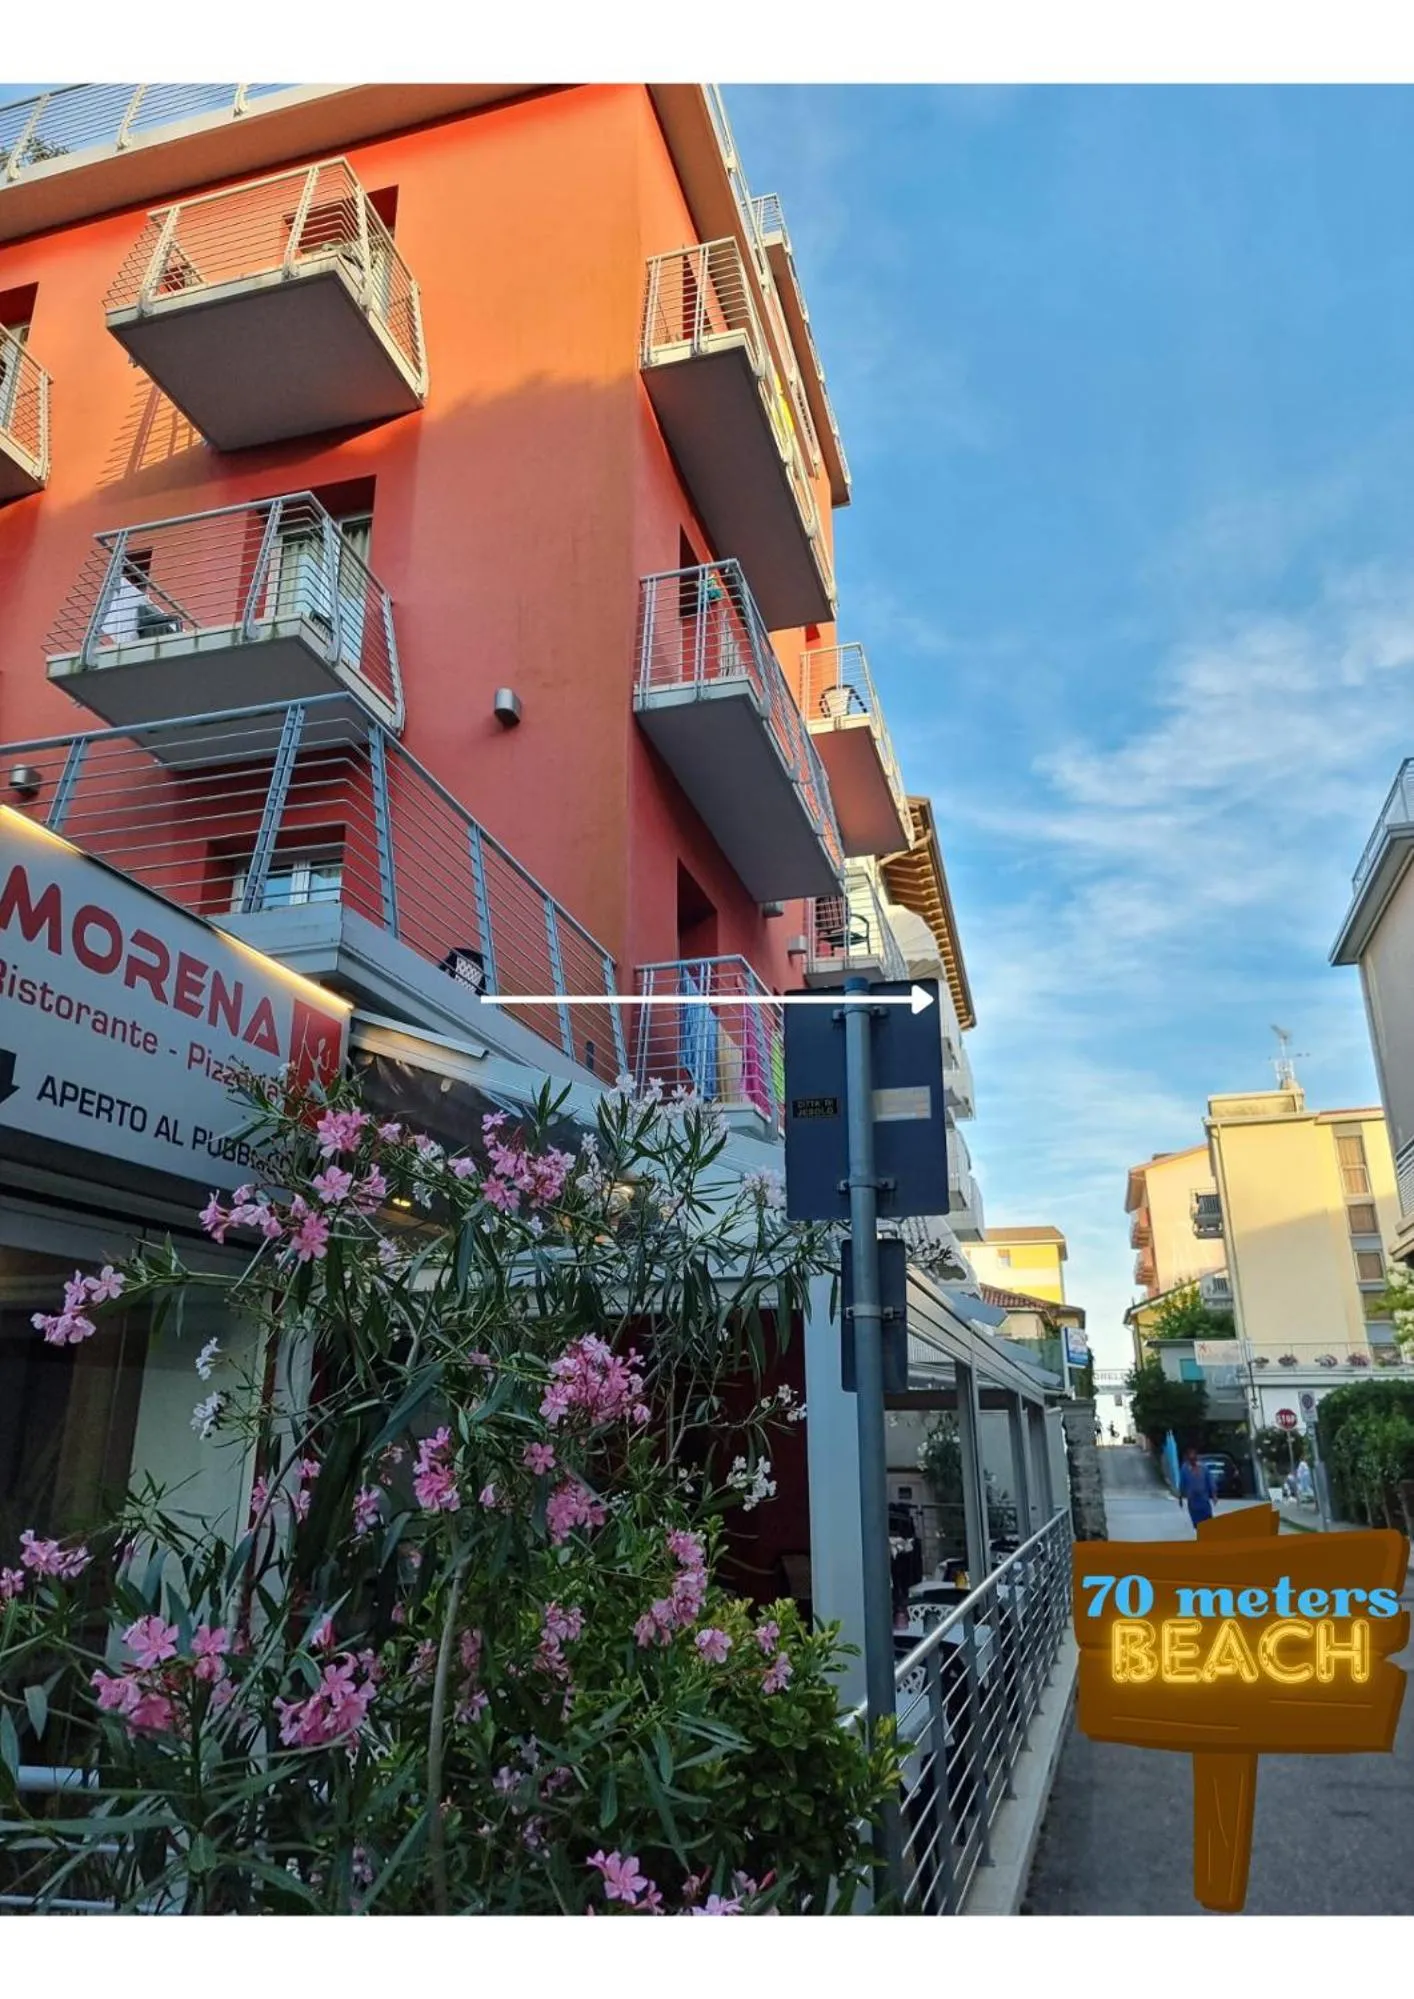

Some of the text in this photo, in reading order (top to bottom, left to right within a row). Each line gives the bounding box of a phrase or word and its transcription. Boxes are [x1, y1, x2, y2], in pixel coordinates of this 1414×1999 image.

[0, 865, 280, 1057] MORENA
[187, 1042, 278, 1104] Pizzeia
[37, 1075, 293, 1176] APERTO AL PUBBC
[1276, 1414, 1295, 1425] STOP
